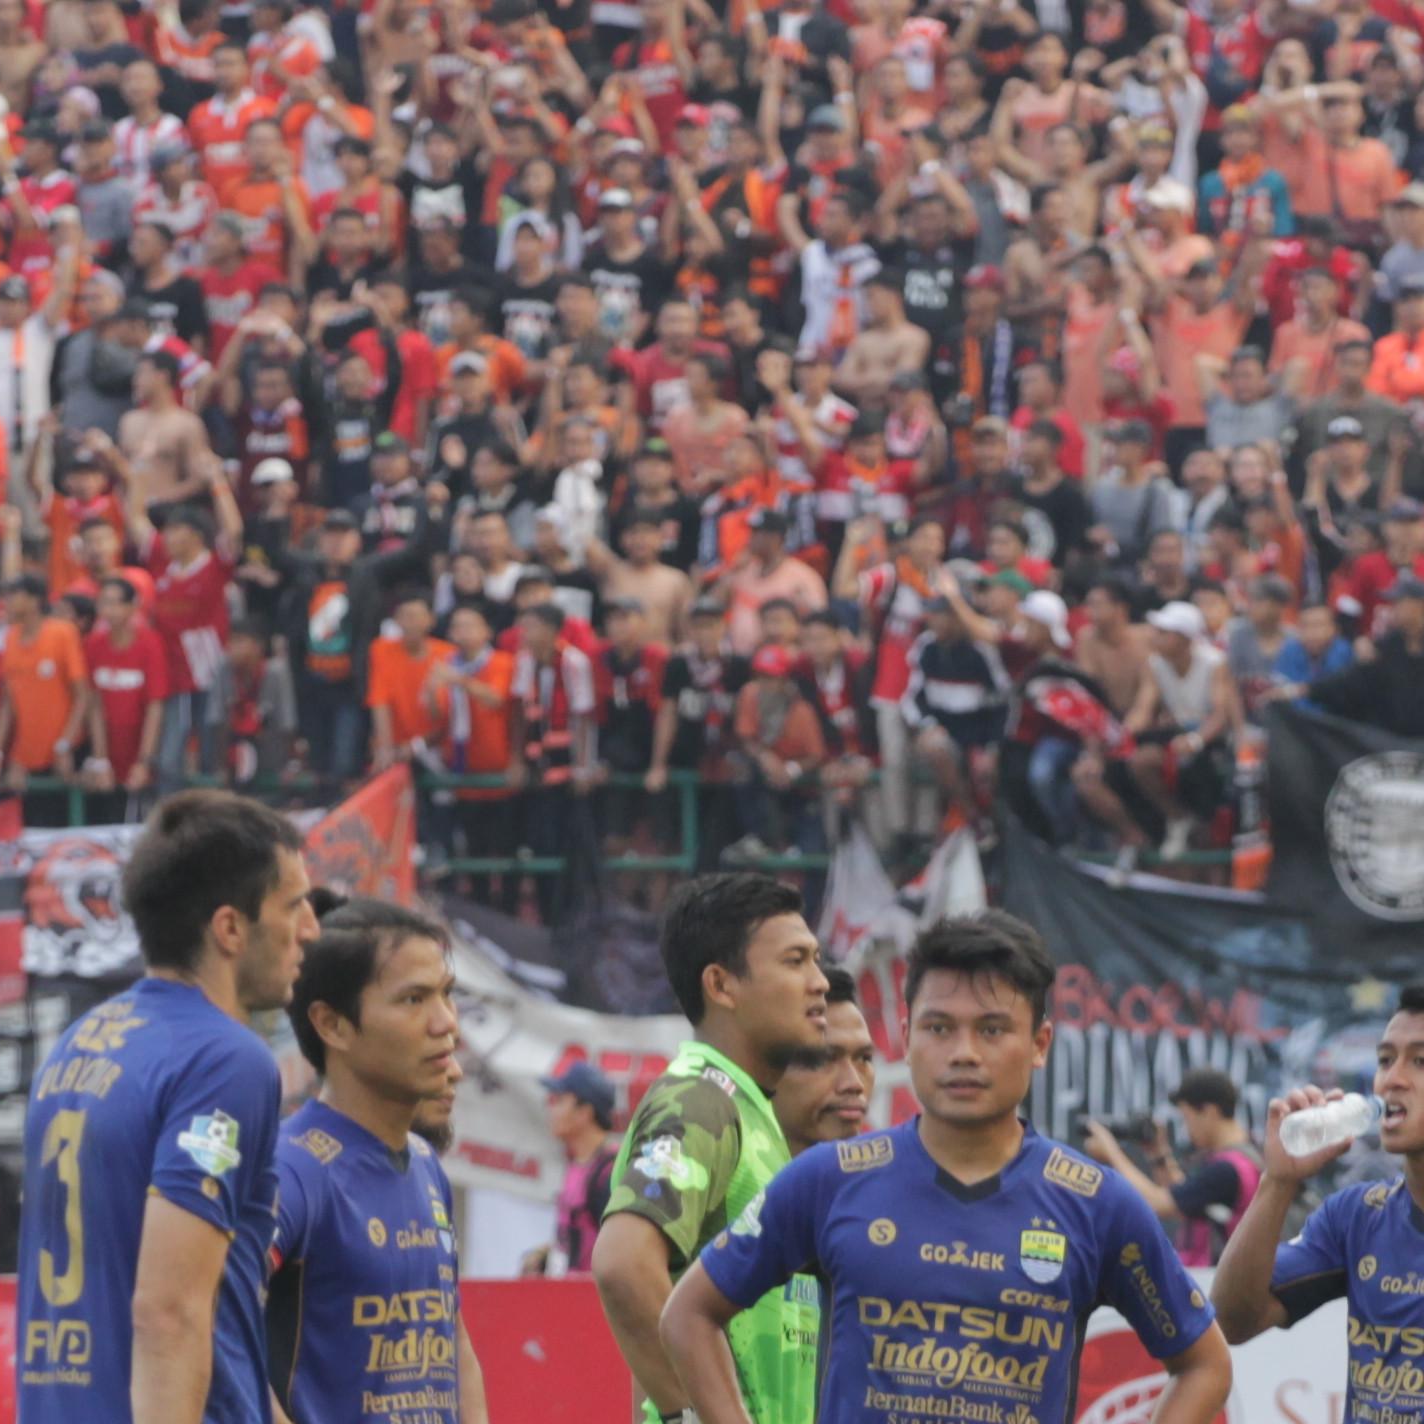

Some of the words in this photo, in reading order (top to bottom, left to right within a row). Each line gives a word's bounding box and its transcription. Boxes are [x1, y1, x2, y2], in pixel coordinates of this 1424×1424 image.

[39, 1108, 87, 1307] 3
[352, 1289, 456, 1327] DATSU
[857, 1296, 1064, 1350] DATSUN
[867, 1334, 1049, 1388] Indofood
